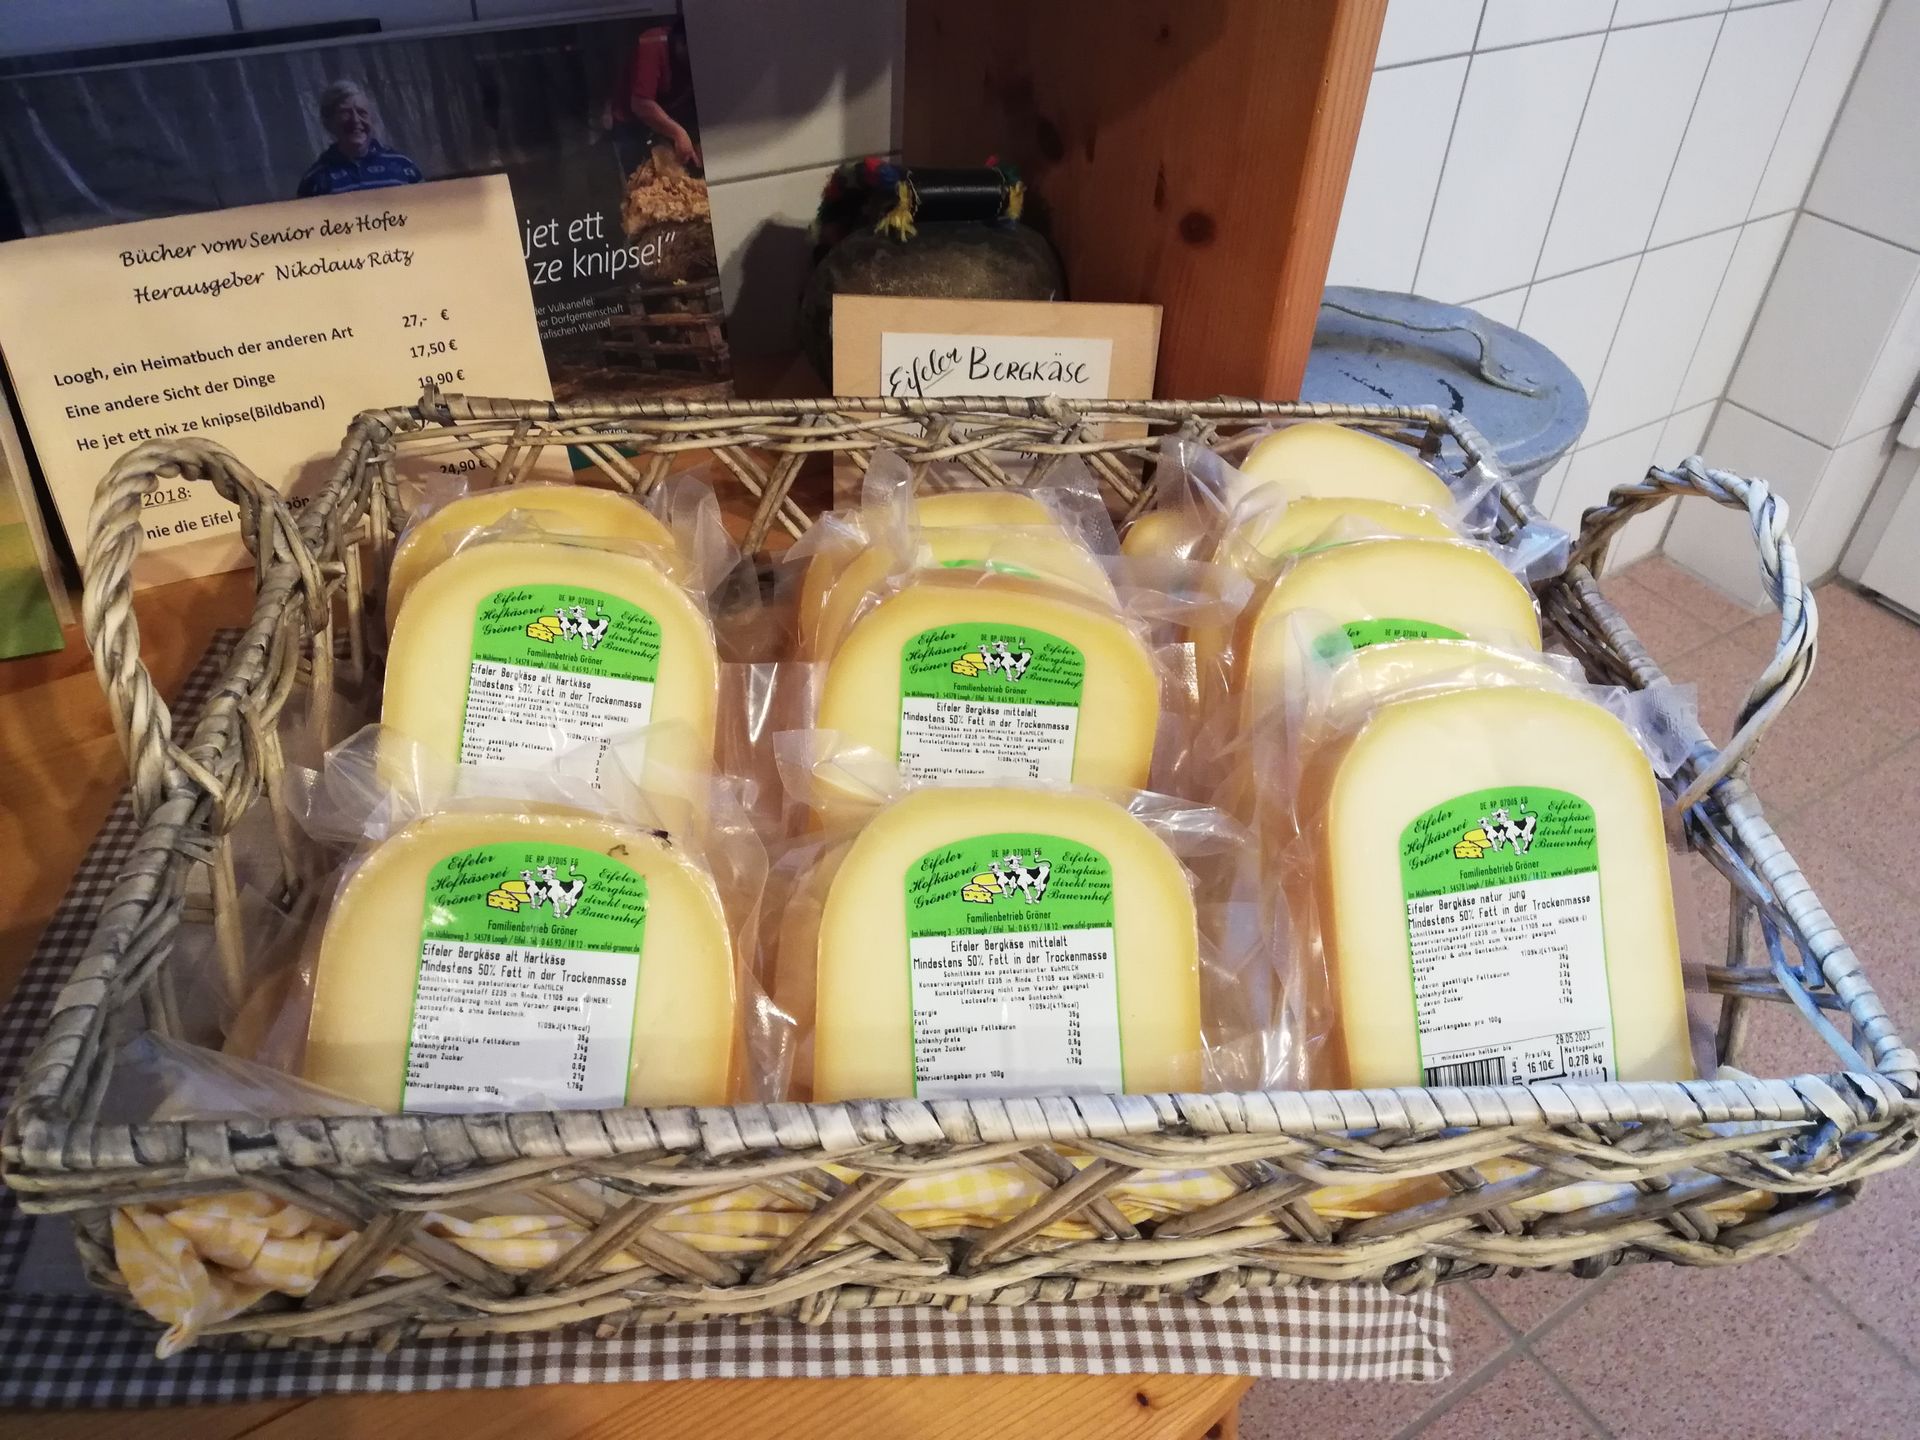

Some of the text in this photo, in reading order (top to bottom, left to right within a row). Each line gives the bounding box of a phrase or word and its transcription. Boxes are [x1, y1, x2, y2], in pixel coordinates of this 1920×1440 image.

[120, 211, 408, 266] Bücher vom Senior des Hofes
[524, 212, 604, 259] jet ett
[133, 249, 414, 304] Herausgeber Nikolaus Rätz
[533, 259, 562, 285] ze
[548, 296, 594, 313] Vulkaneifel
[402, 309, 449, 328] 27,- €
[551, 304, 624, 325] Dorfgemeinschaft
[579, 318, 611, 332] Wandel
[54, 326, 354, 387] Loogh, ein Heimatbuch der anderen Art
[410, 339, 458, 358] 17,50 €
[457, 369, 465, 381] €
[65, 373, 276, 420] Eine andere Sicht der Dinge
[76, 438, 99, 451] He
[103, 432, 124, 450] jet
[128, 427, 152, 441] ett
[155, 423, 179, 437] nix
[182, 420, 199, 432] ze
[144, 487, 191, 506] 2018:
[174, 521, 197, 534] die
[201, 511, 234, 528] Eifel
[493, 591, 534, 604] Eifeler
[480, 607, 545, 622] Hofkäserei
[620, 611, 653, 625] Eifeler
[482, 623, 523, 636] Gröner
[918, 631, 957, 645] Eifeler
[527, 648, 602, 665] Familienbetrieb Gröner
[602, 642, 658, 661] Bauernhof
[906, 642, 968, 661] Hofkäserei
[1043, 643, 1075, 656] Eifeler
[471, 663, 591, 689] Eifeler Bergkäse alt Hartkäse
[909, 661, 948, 674] Gröner
[954, 682, 1027, 694] Familienbetrieb Gröner
[1026, 672, 1083, 689] Bauernhof
[469, 676, 642, 709] Mindestens 50% Fett in der Trockenmasse
[937, 702, 1037, 717] Eifeler Bergkäse mittelalt
[903, 712, 1069, 730] Mindestens 50% Fett in der Trockenmasse
[1548, 800, 1583, 812] Eifeler
[1414, 810, 1453, 834] Eifeler
[1540, 813, 1592, 824] Bergkäse
[1404, 818, 1468, 857] Hofkäserei
[1539, 826, 1594, 837] direkt vom
[1535, 837, 1595, 850] Bauernhof
[447, 852, 496, 871] Eifeler
[921, 851, 962, 873] Eifeler
[1062, 852, 1099, 865] Eifeler
[1408, 848, 1450, 870] Gröner
[598, 868, 638, 884] Eifeler
[909, 862, 978, 894] Hofkäserei
[1054, 864, 1107, 880] Bergkäse
[1460, 861, 1539, 880] Familienbetrieb Gröner
[431, 869, 510, 891] Hofkäserei
[1052, 877, 1111, 889] direkt vom
[588, 881, 643, 898] Bergkäse
[913, 888, 957, 909] Gröner
[1047, 890, 1112, 904] Bauernhof
[435, 891, 484, 907] Gröner
[584, 895, 645, 912] direkt vom
[1407, 889, 1526, 915] Eifeler Bergkäse natur jung
[576, 908, 644, 928] Bauernhof
[967, 911, 1051, 924] Familienbetrieb Gröner
[1408, 894, 1591, 929] Mindestens 50% Fett in der Trockenmasse
[487, 919, 578, 936] Familienbetrieb Gröner
[951, 936, 1068, 952] Eifeler Bergkäse mittelalt
[422, 944, 565, 966] Eifeler Bergkäse alt Hartkäse
[913, 951, 1108, 969] Mindestens 50% Fett in der Trockenmasse
[420, 960, 627, 986] Mindestens 50% Fett in der Trockenmasse
[1593, 1055, 1602, 1064] kg
